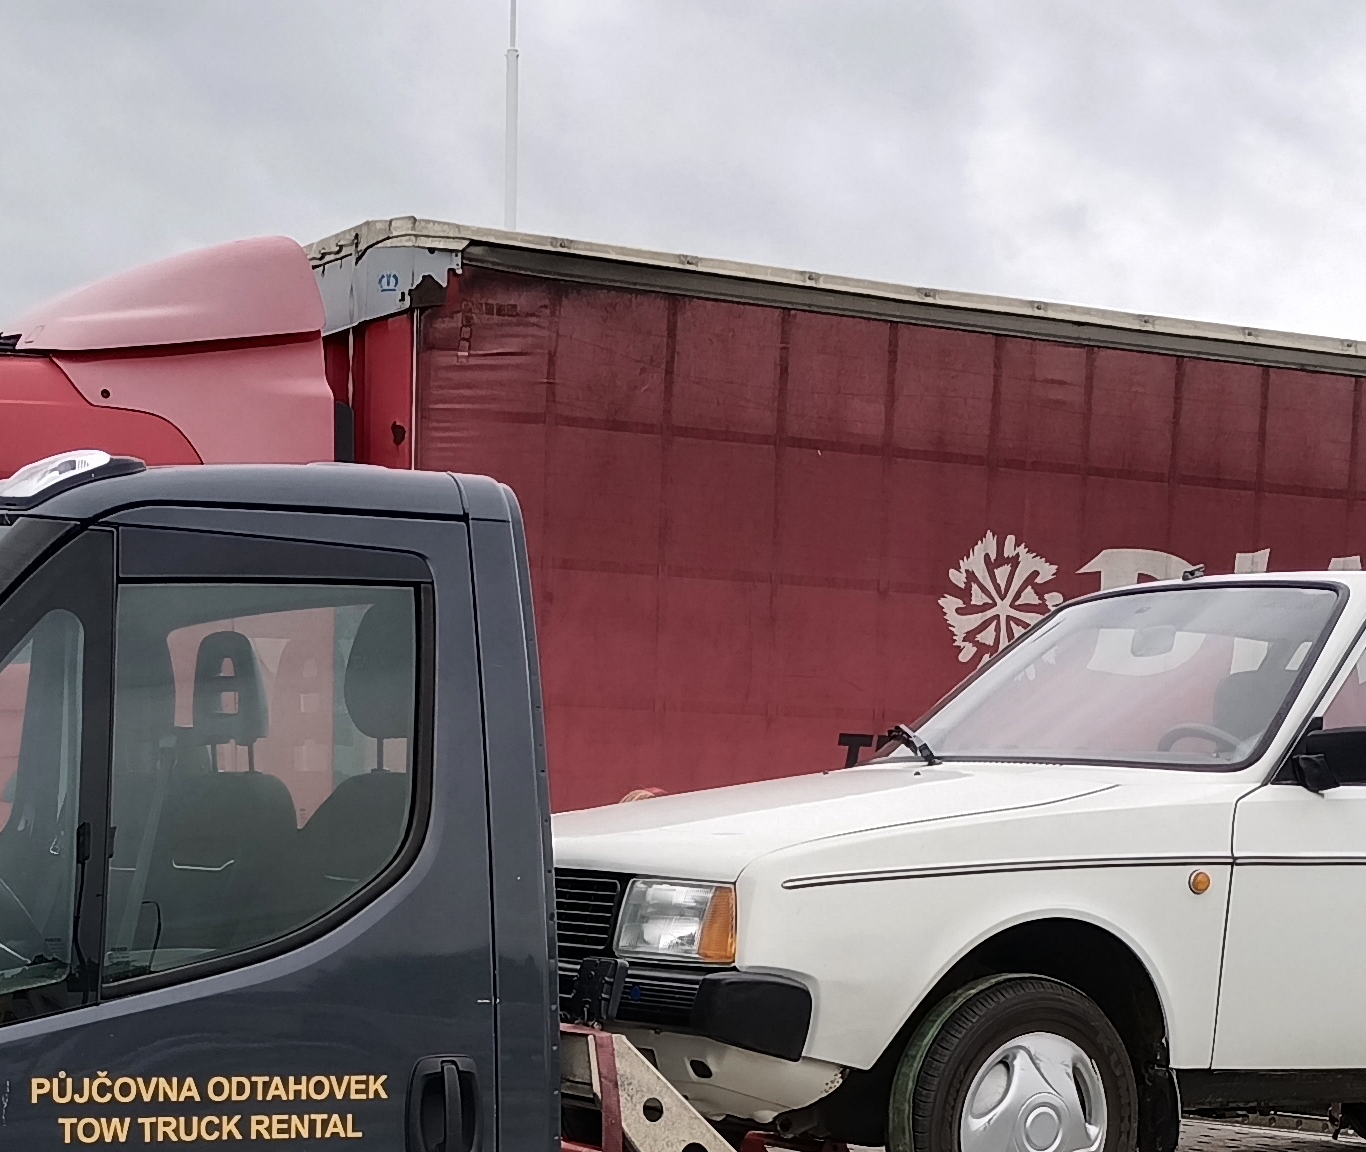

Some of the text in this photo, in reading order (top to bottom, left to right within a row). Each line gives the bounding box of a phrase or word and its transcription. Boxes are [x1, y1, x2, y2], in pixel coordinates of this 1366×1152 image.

[31, 1070, 388, 1104] PŮJČOVNA ODTAHOVEK
[58, 1113, 363, 1144] TOW TRUCK RENTAL
